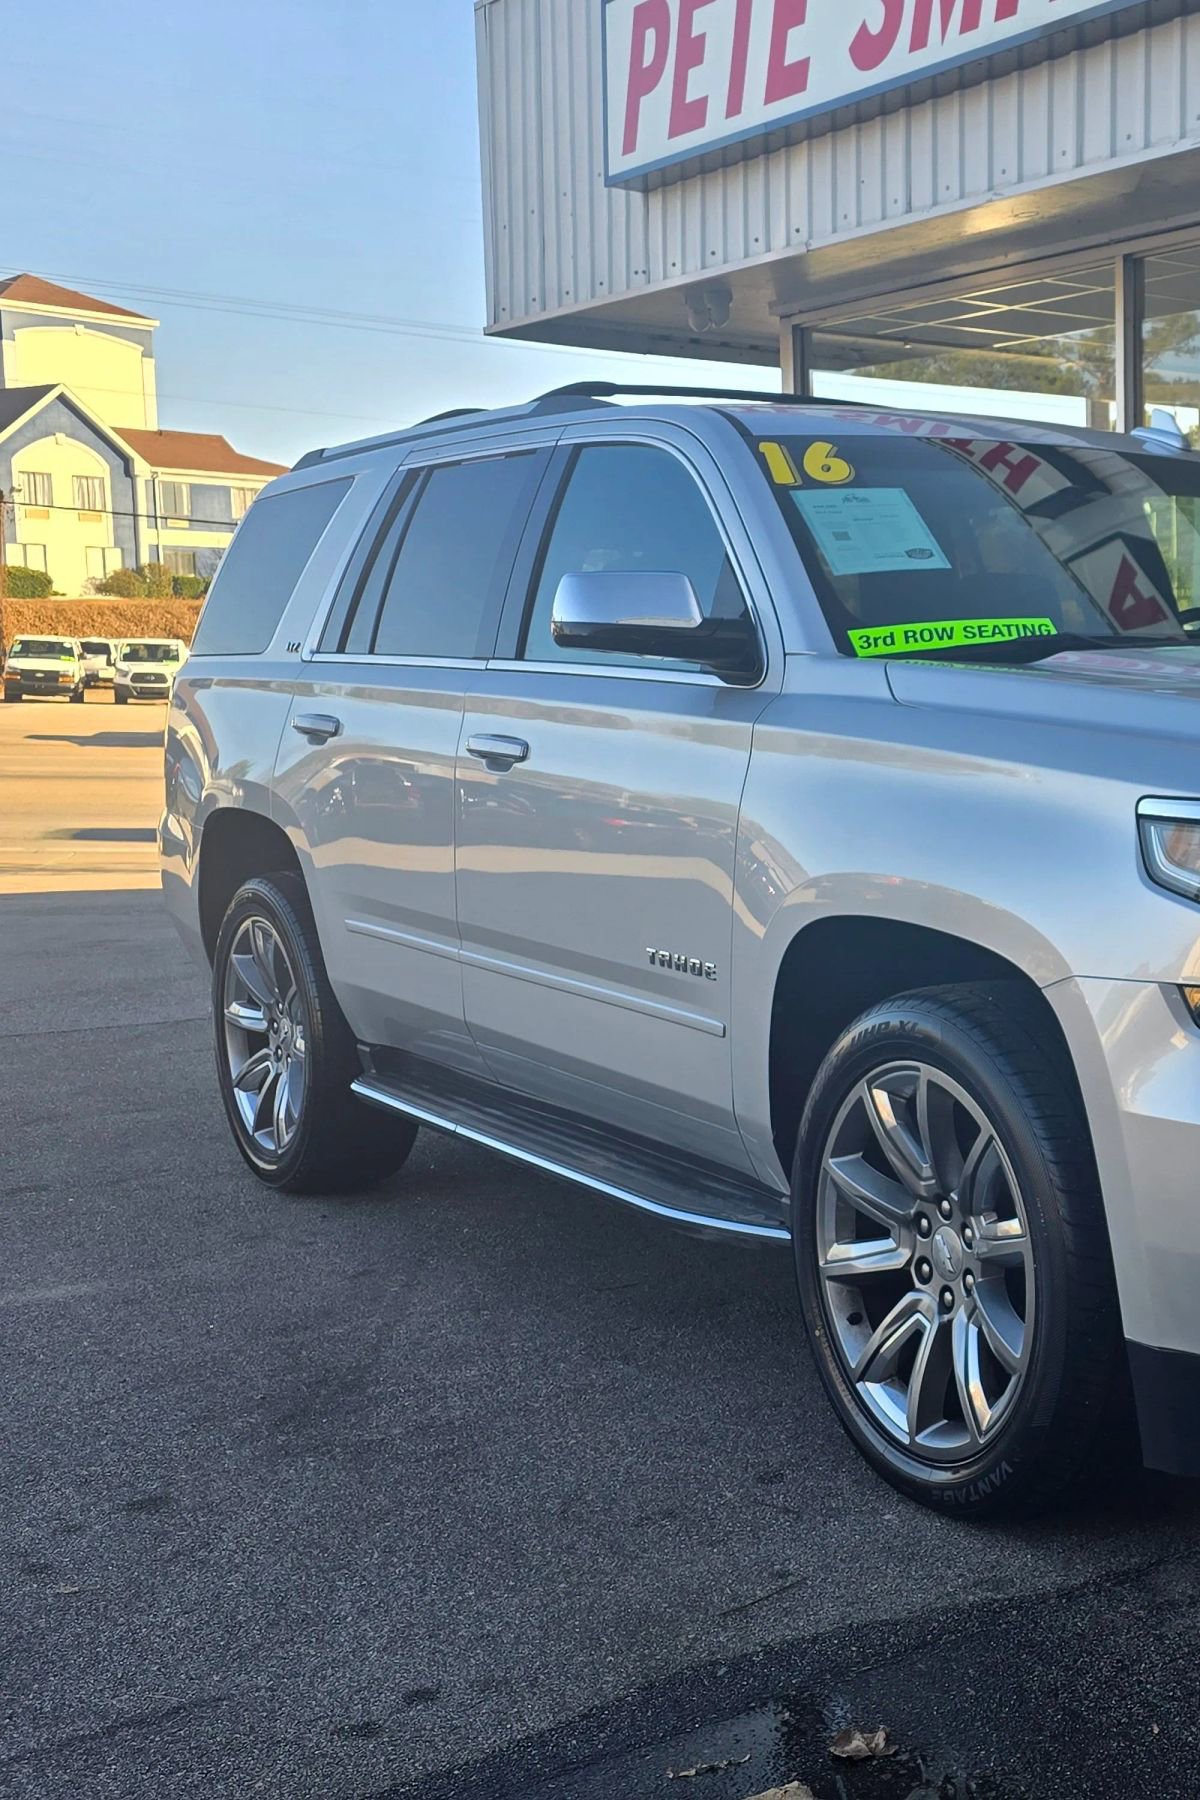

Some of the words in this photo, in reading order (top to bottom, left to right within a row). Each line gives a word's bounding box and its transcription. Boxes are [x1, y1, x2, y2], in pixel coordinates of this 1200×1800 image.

[620, 0, 811, 156] PETE
[758, 440, 855, 486] 16
[858, 631, 896, 650] 3rd
[904, 626, 955, 645] ROW
[962, 622, 1051, 640] SEATING
[645, 946, 718, 982] TAHOE
